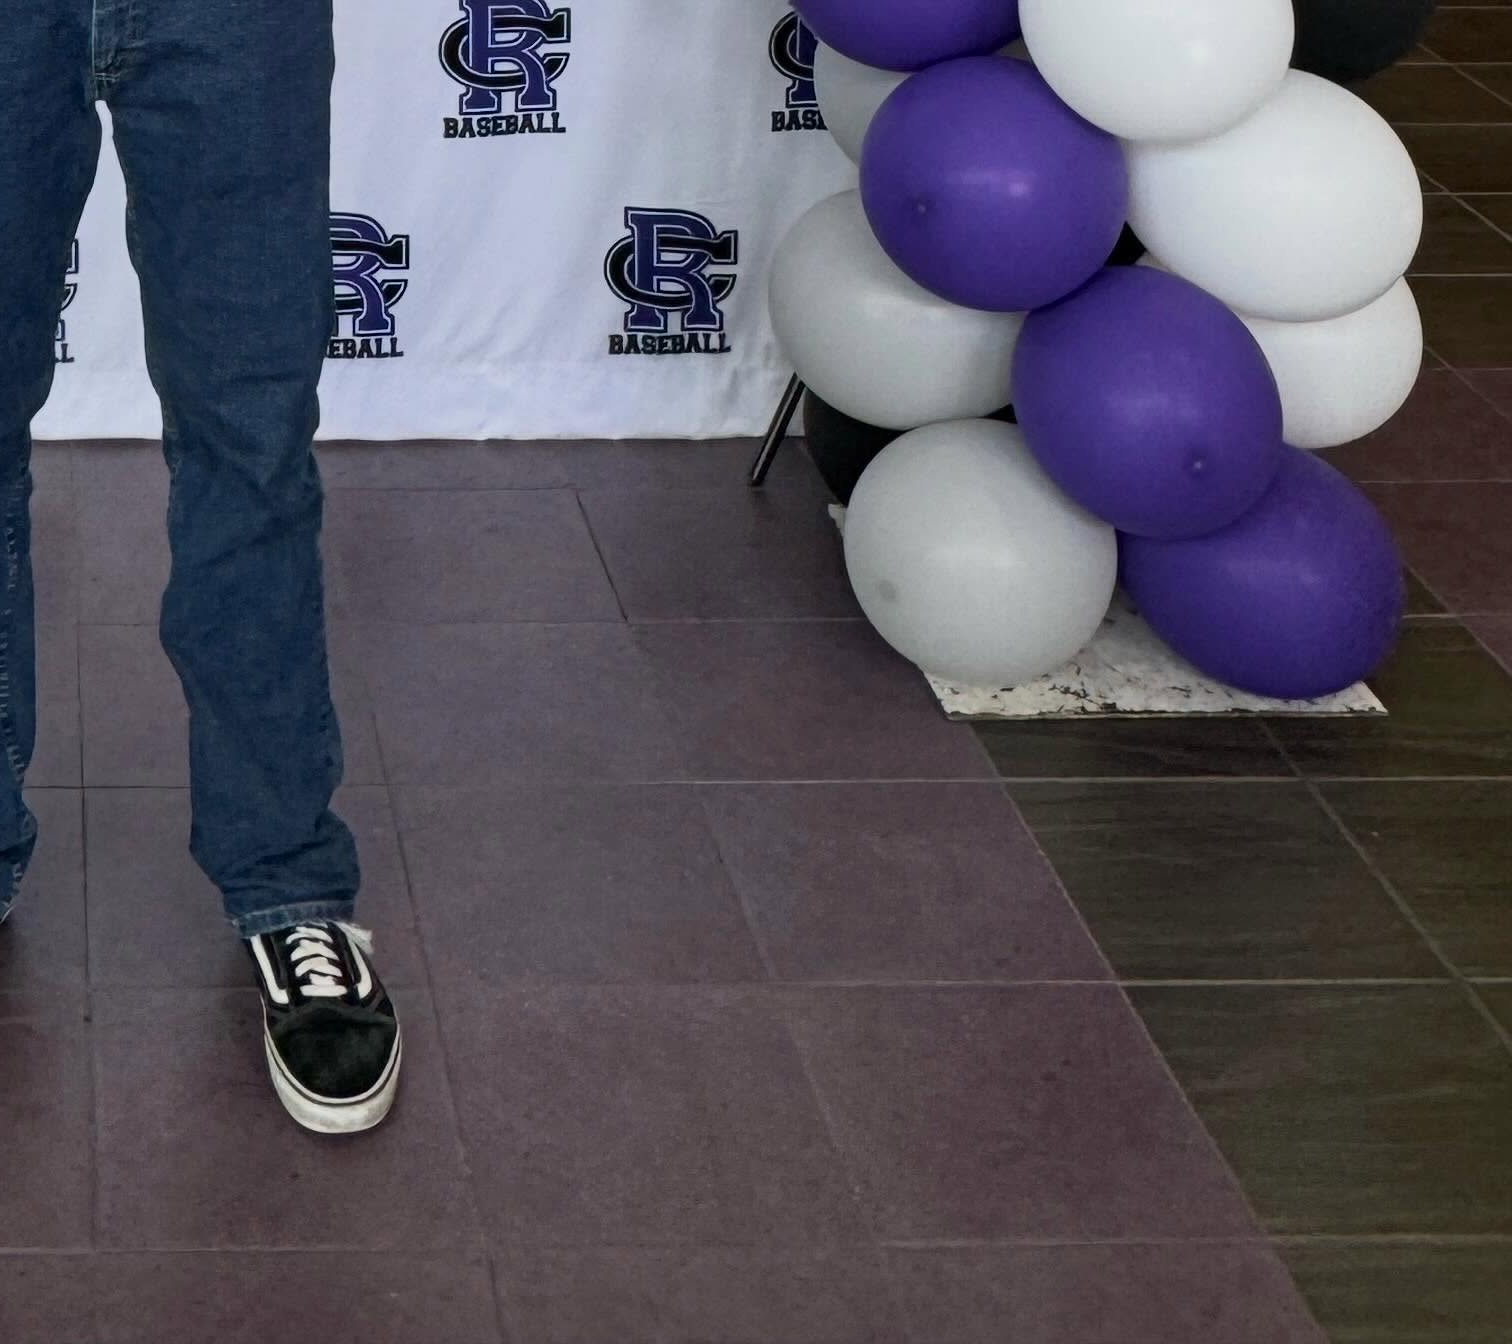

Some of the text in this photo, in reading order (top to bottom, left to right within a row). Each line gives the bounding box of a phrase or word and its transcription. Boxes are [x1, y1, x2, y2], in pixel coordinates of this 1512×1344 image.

[443, 114, 566, 138] BASEBALL
[328, 338, 404, 359] EBALL
[609, 333, 732, 355] BASEBALL
